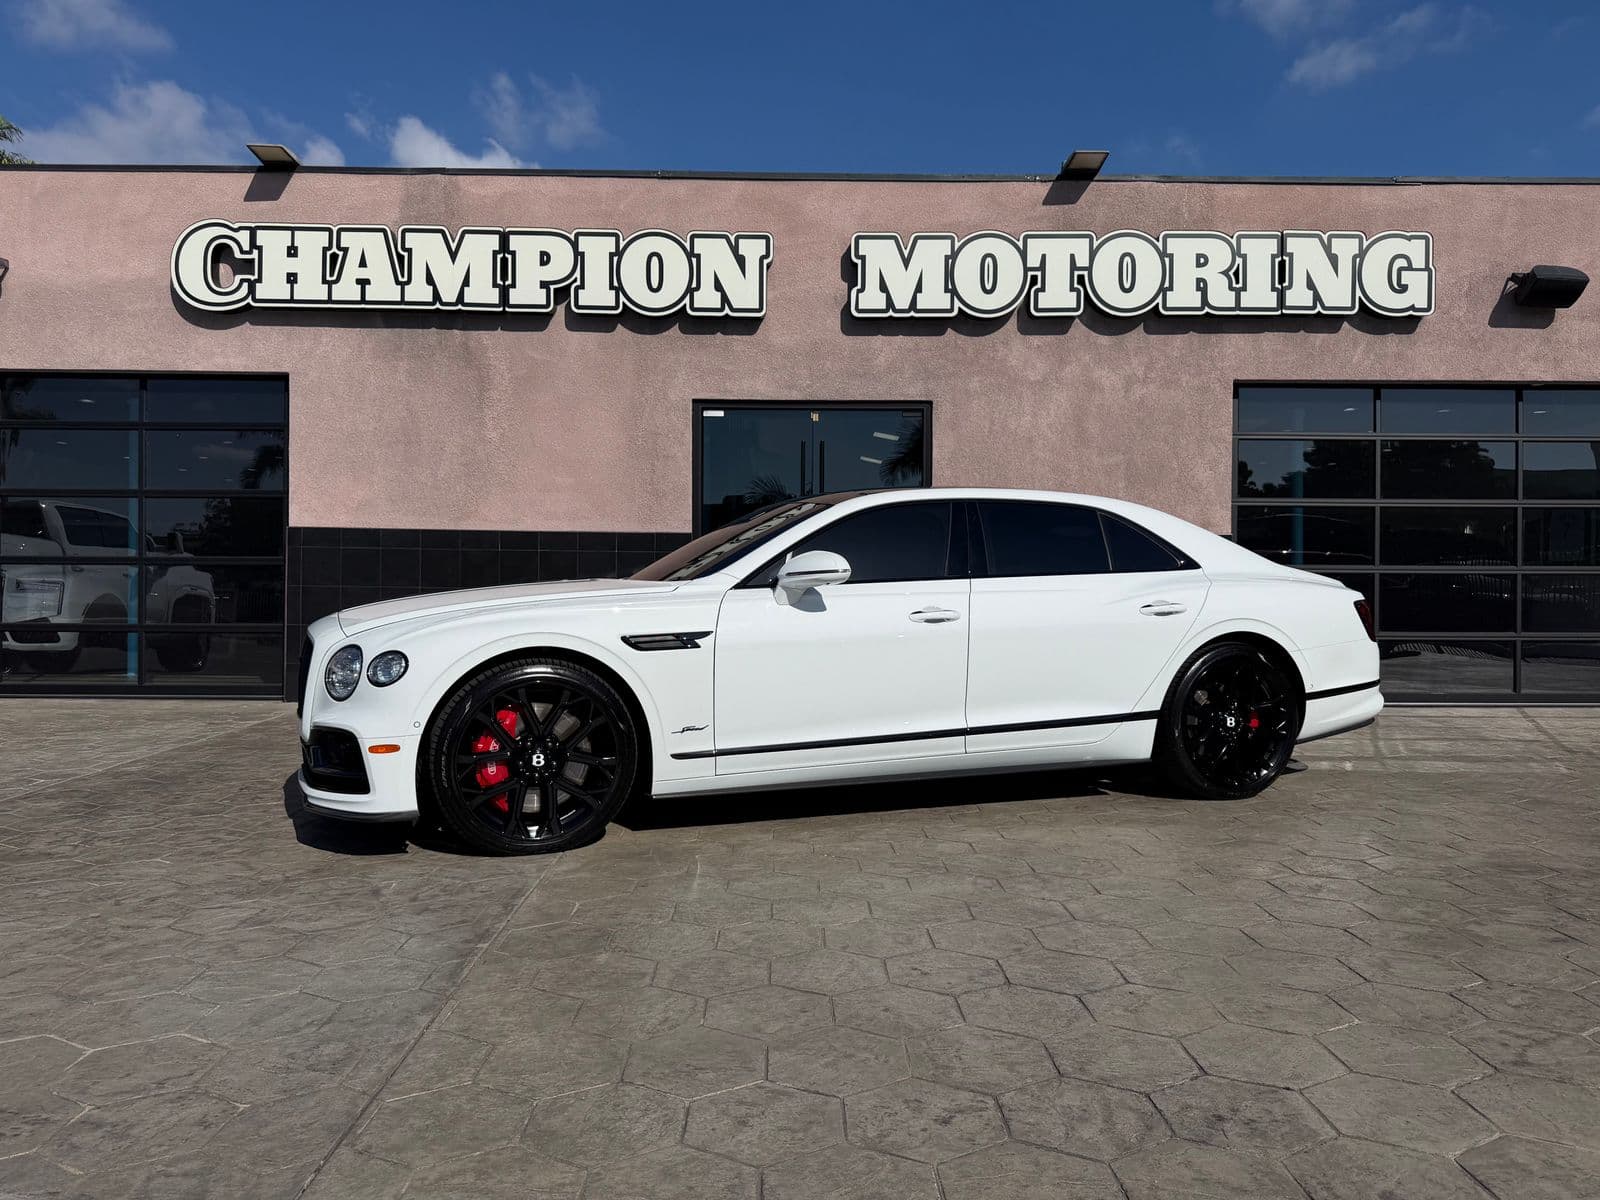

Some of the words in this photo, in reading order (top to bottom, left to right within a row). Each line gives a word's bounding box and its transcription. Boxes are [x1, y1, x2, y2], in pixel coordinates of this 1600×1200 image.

[172, 220, 772, 316] CHAMPION
[852, 230, 1435, 317] MOTORING
[1226, 716, 1236, 728] B
[531, 753, 545, 766] B
